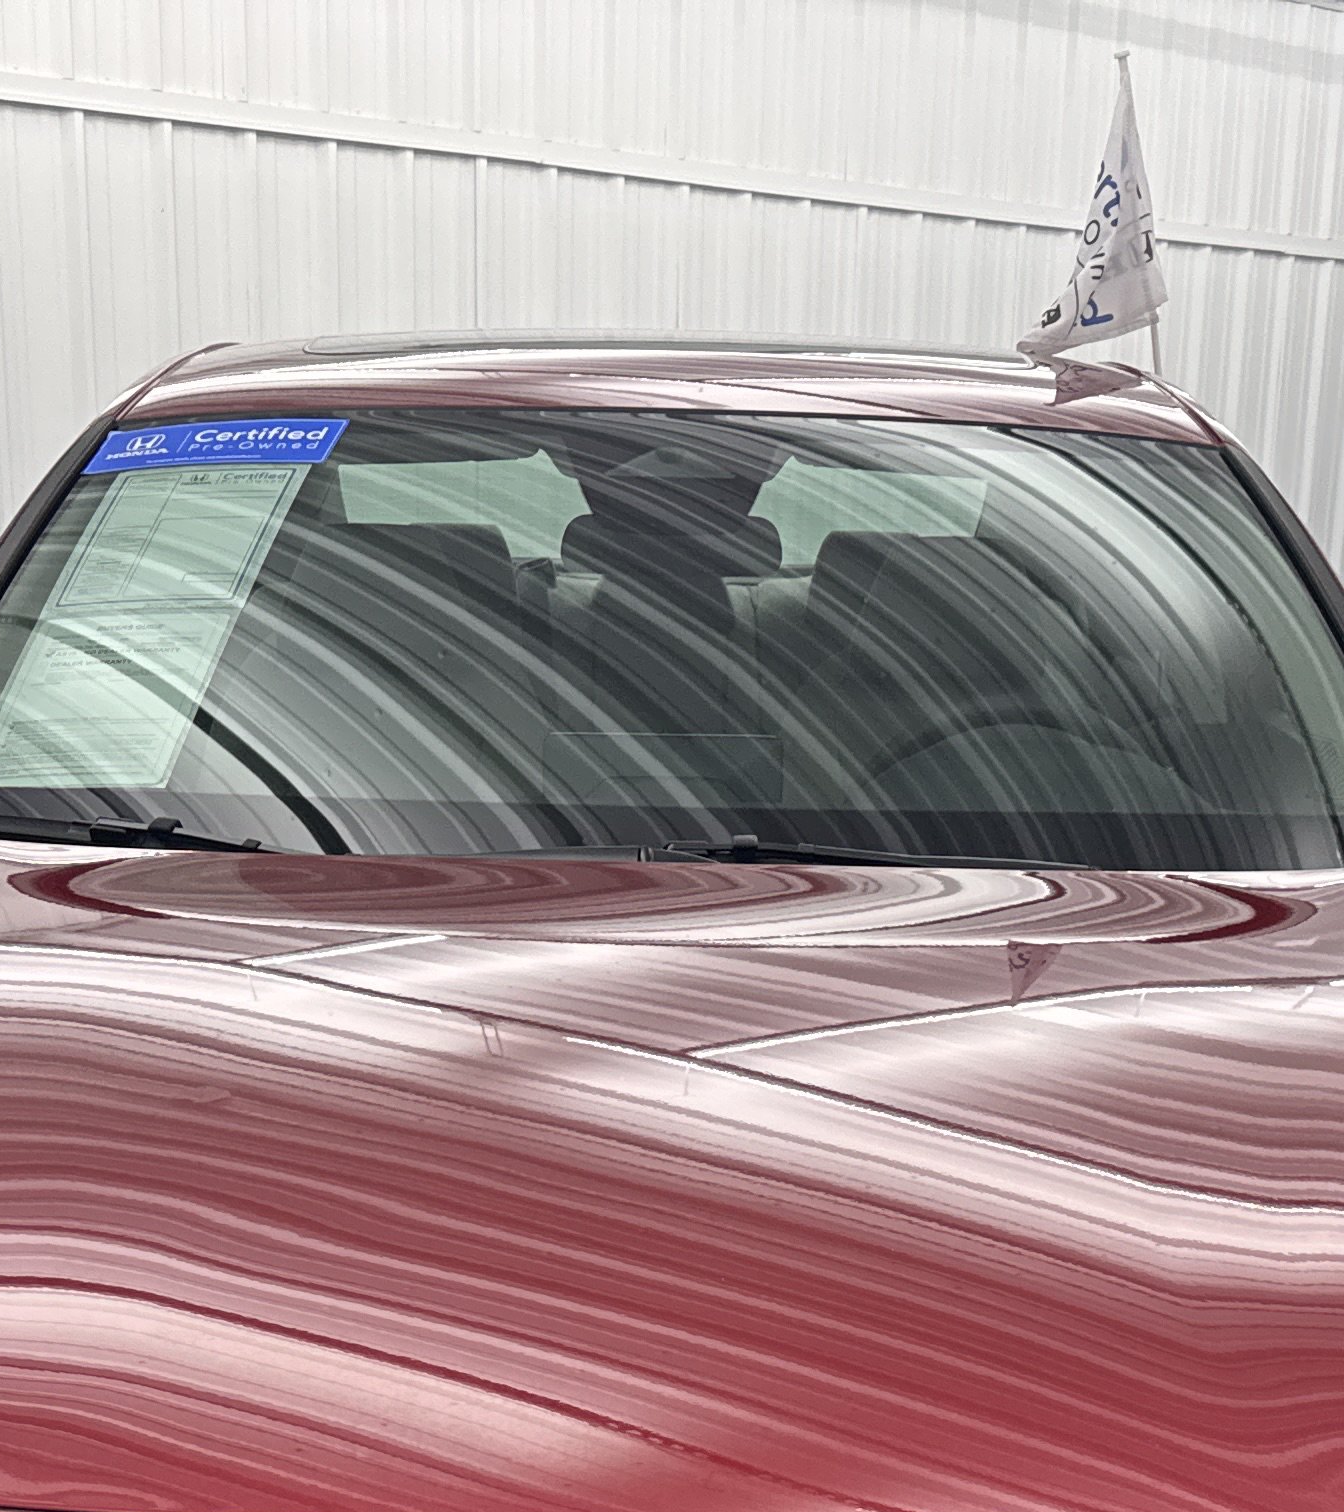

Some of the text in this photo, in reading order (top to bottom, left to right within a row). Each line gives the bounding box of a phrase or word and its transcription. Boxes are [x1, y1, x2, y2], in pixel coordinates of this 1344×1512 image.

[194, 426, 329, 443] Certified
[187, 440, 320, 452] Pre-Owned
[105, 447, 169, 460] HONDA
